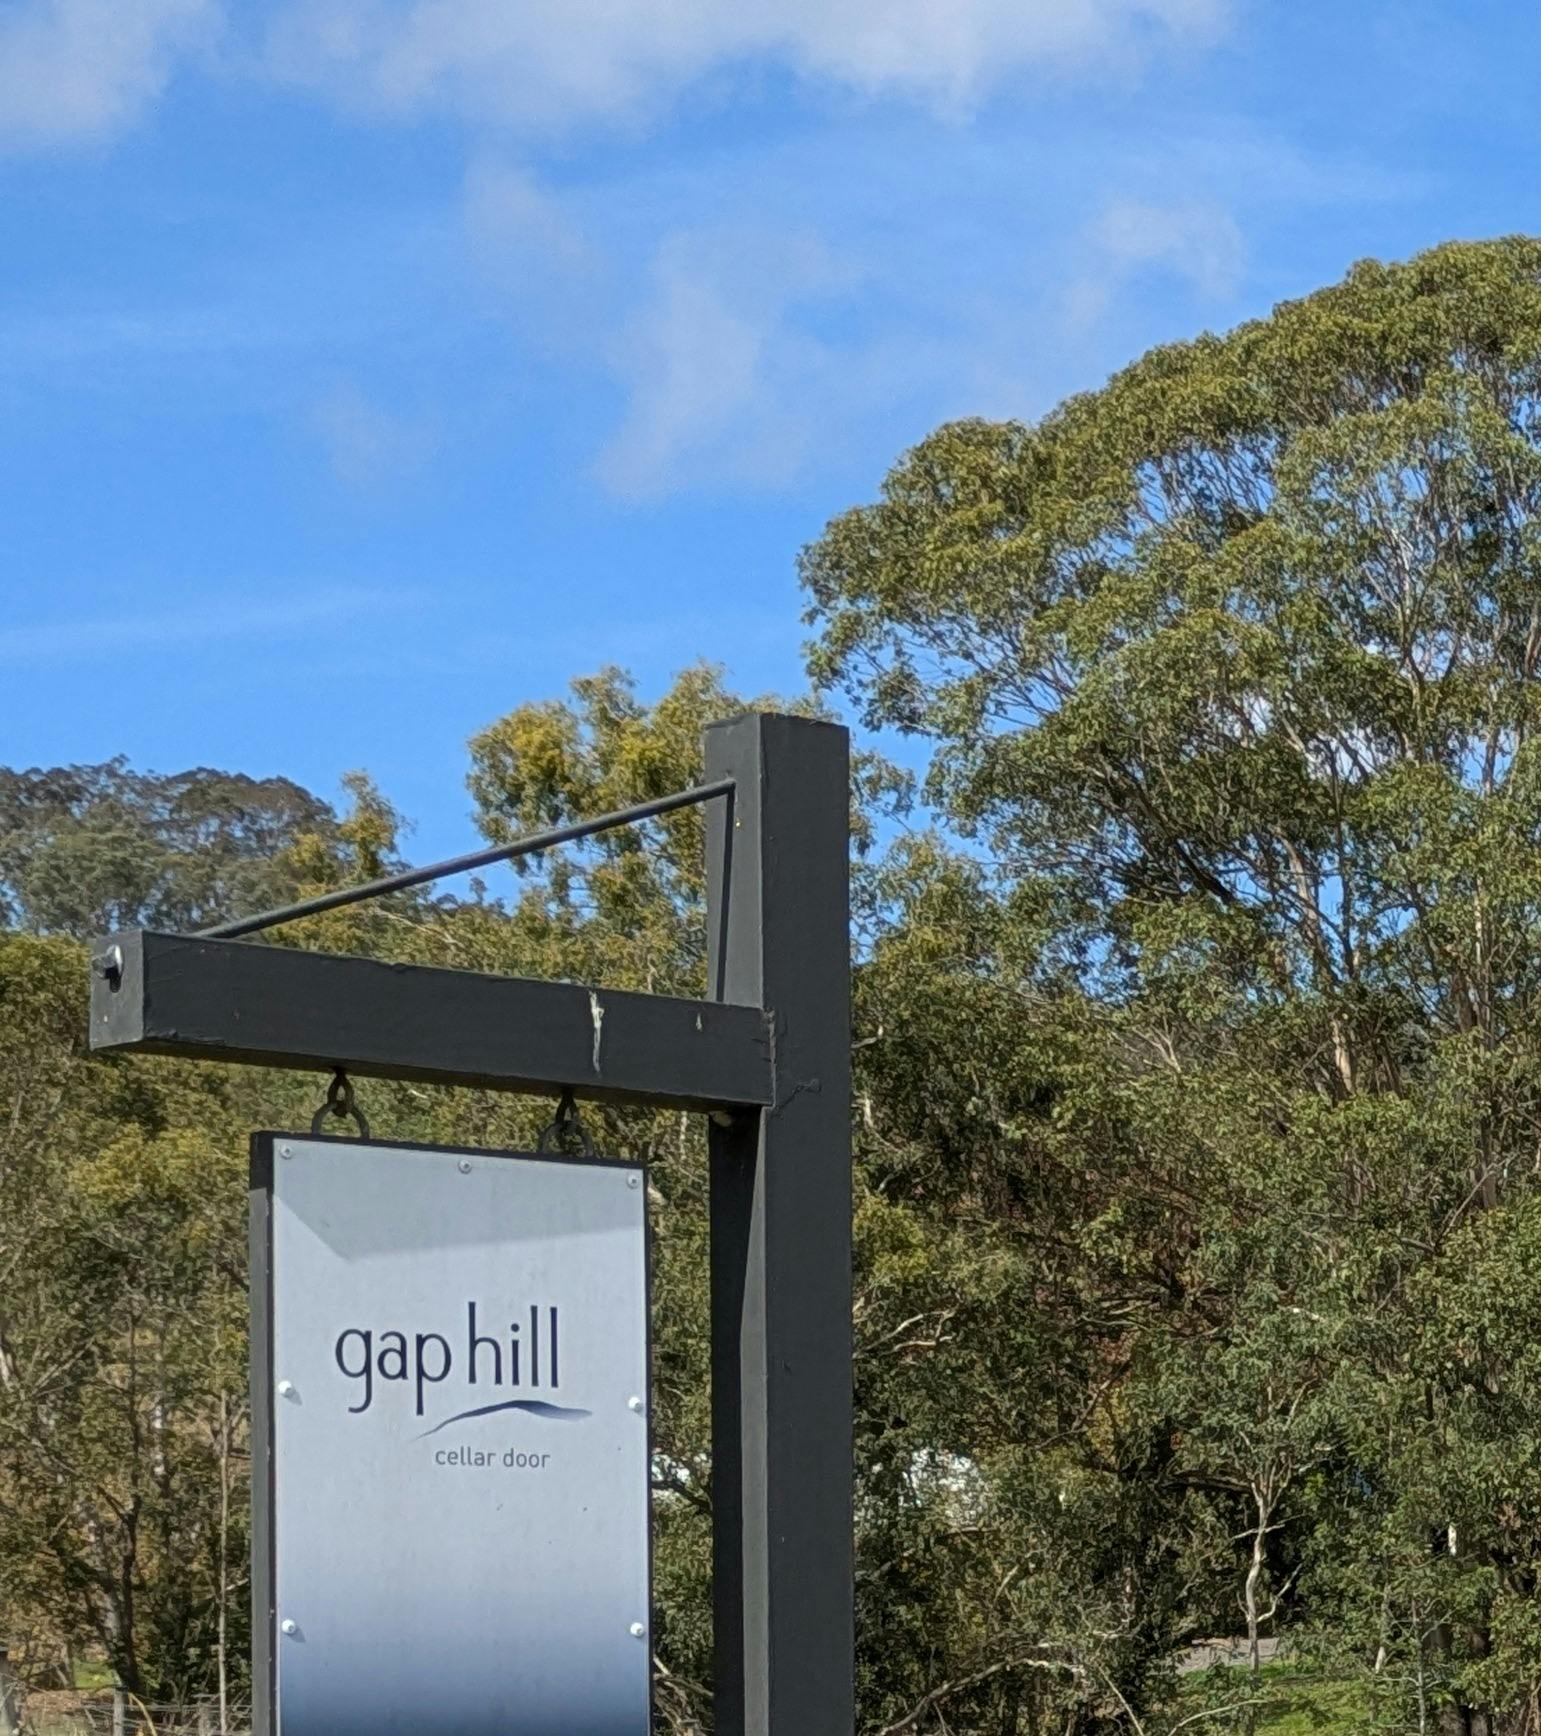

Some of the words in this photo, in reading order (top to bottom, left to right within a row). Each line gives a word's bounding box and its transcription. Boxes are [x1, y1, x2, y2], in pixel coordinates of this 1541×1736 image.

[335, 1328, 452, 1416] gap
[468, 1301, 558, 1388] hill
[435, 1446, 496, 1467] cellar
[503, 1447, 550, 1468] door
